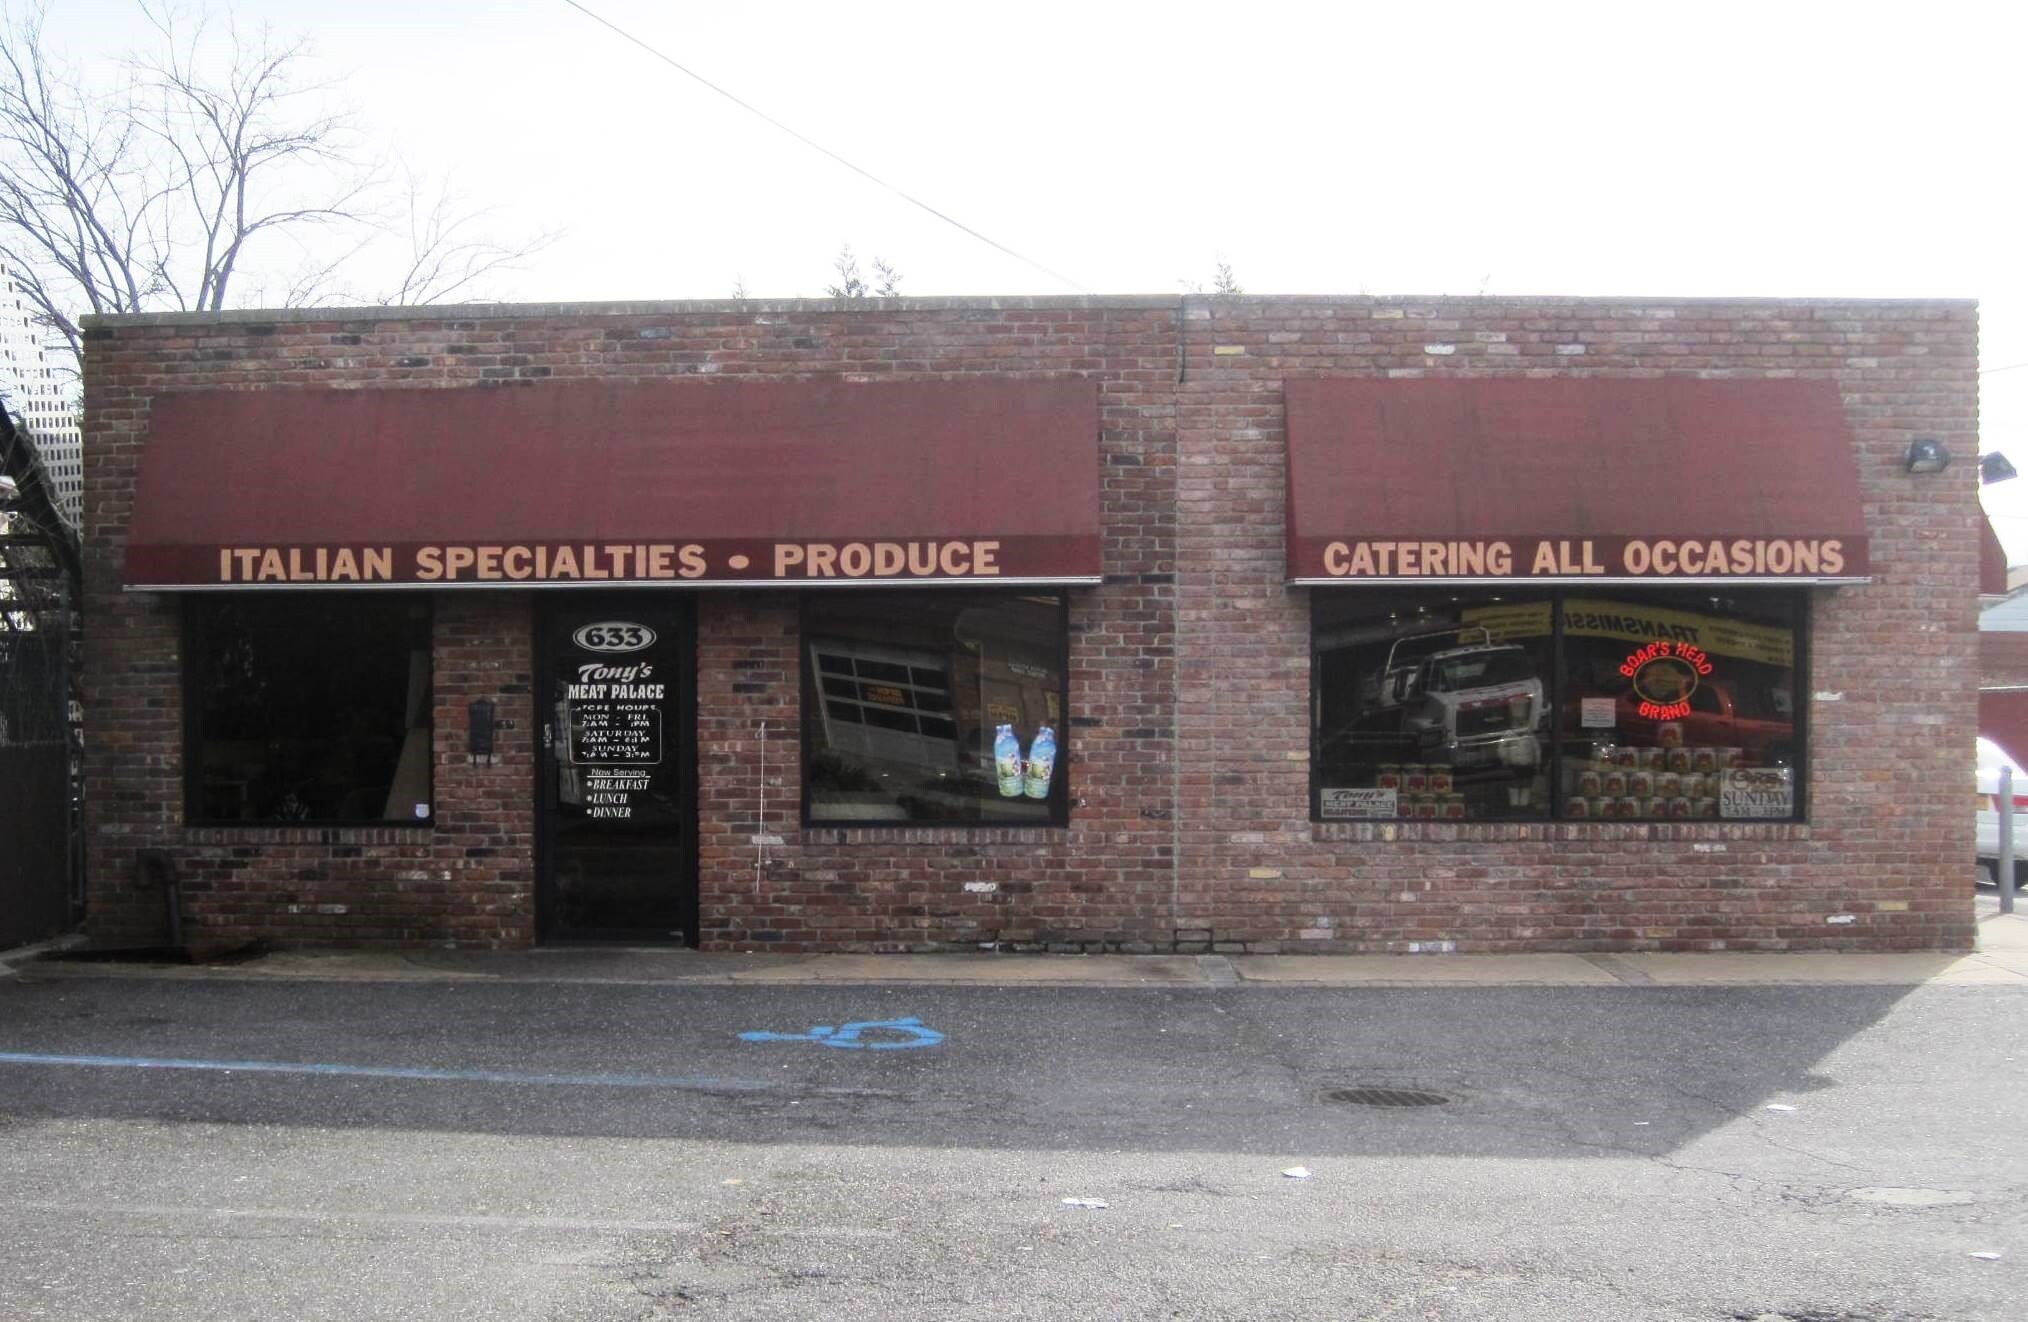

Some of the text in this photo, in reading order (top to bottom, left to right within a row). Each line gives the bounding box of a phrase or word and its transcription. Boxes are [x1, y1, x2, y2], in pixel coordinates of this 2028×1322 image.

[219, 540, 1001, 582] ITALIAN SPECIALTIES PRODUCE
[1322, 539, 1845, 576] CATERING ALL OCCASIONS
[584, 626, 644, 648] 633
[1619, 641, 1671, 677] BOAR'S
[1675, 641, 1713, 676] HEAD
[577, 661, 653, 683] Tony's
[567, 684, 665, 700] MEAT PALACE
[583, 713, 610, 721] MON
[1638, 700, 1692, 721] BRAND
[591, 768, 646, 778] Now Serving
[592, 779, 650, 791] BREAKFAST
[592, 792, 628, 804] LUNCH
[592, 806, 632, 818] DINNER
